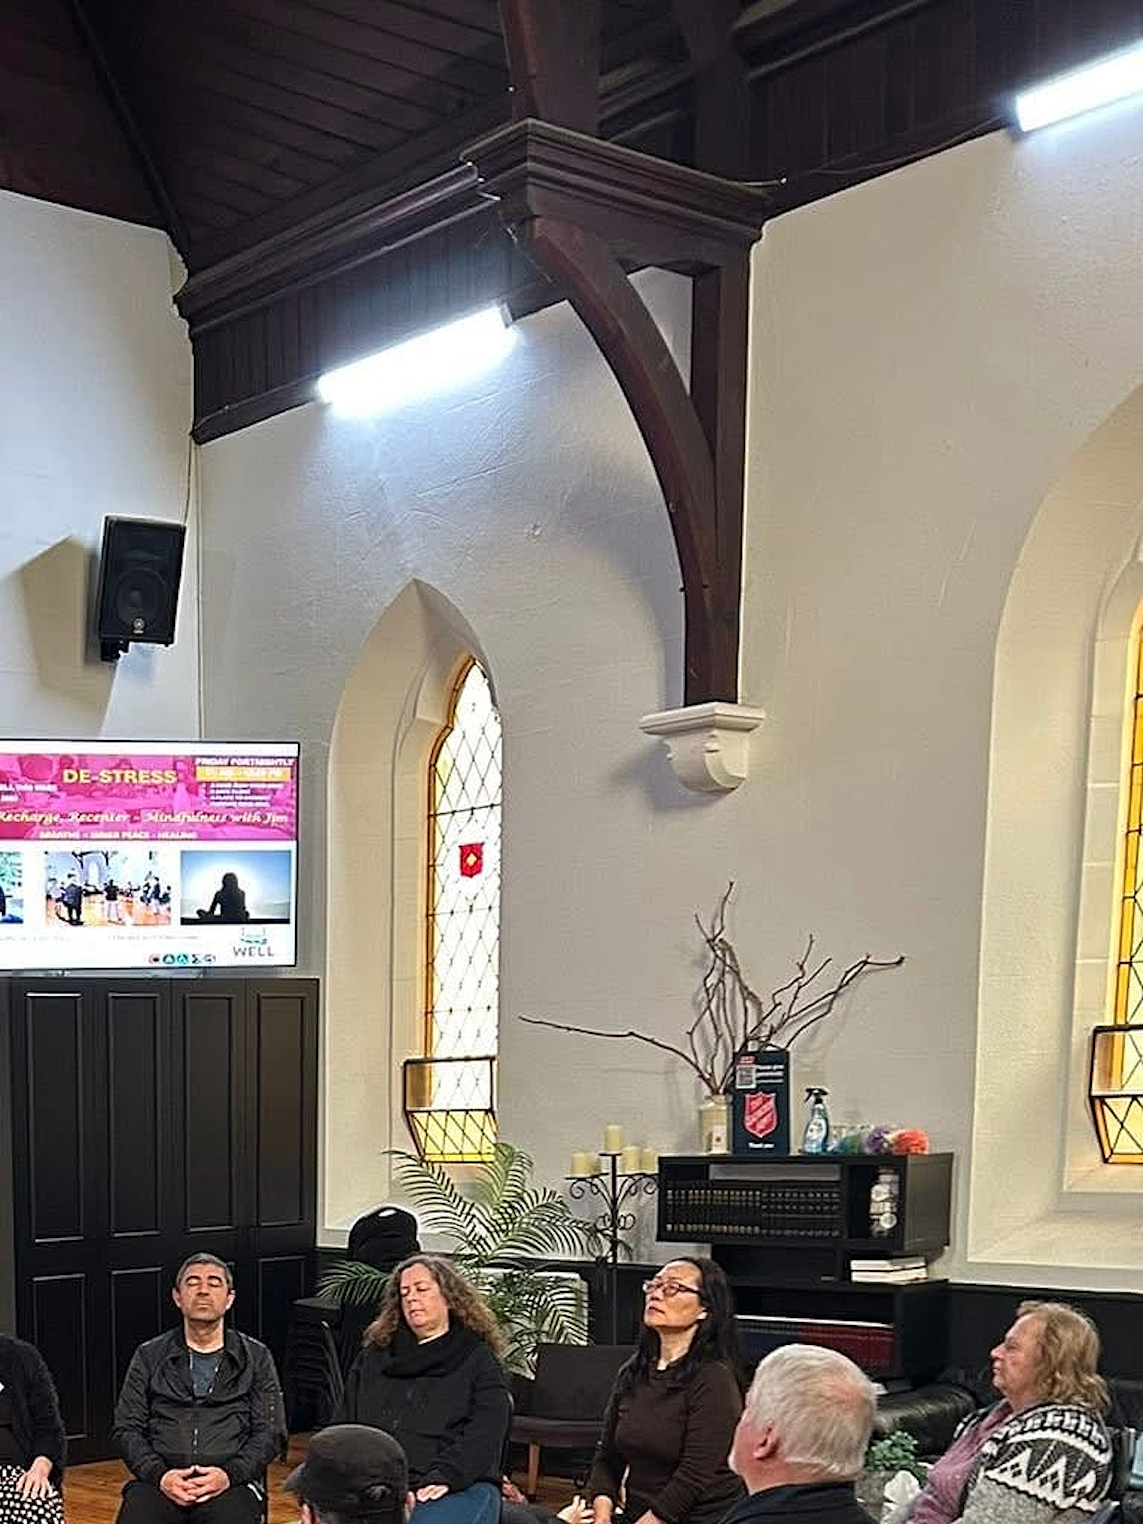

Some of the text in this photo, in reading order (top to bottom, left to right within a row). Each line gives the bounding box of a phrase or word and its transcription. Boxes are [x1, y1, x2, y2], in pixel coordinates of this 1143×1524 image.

[63, 769, 178, 784] DE-STRESS
[230, 810, 262, 823] with
[233, 945, 275, 957] WELL
